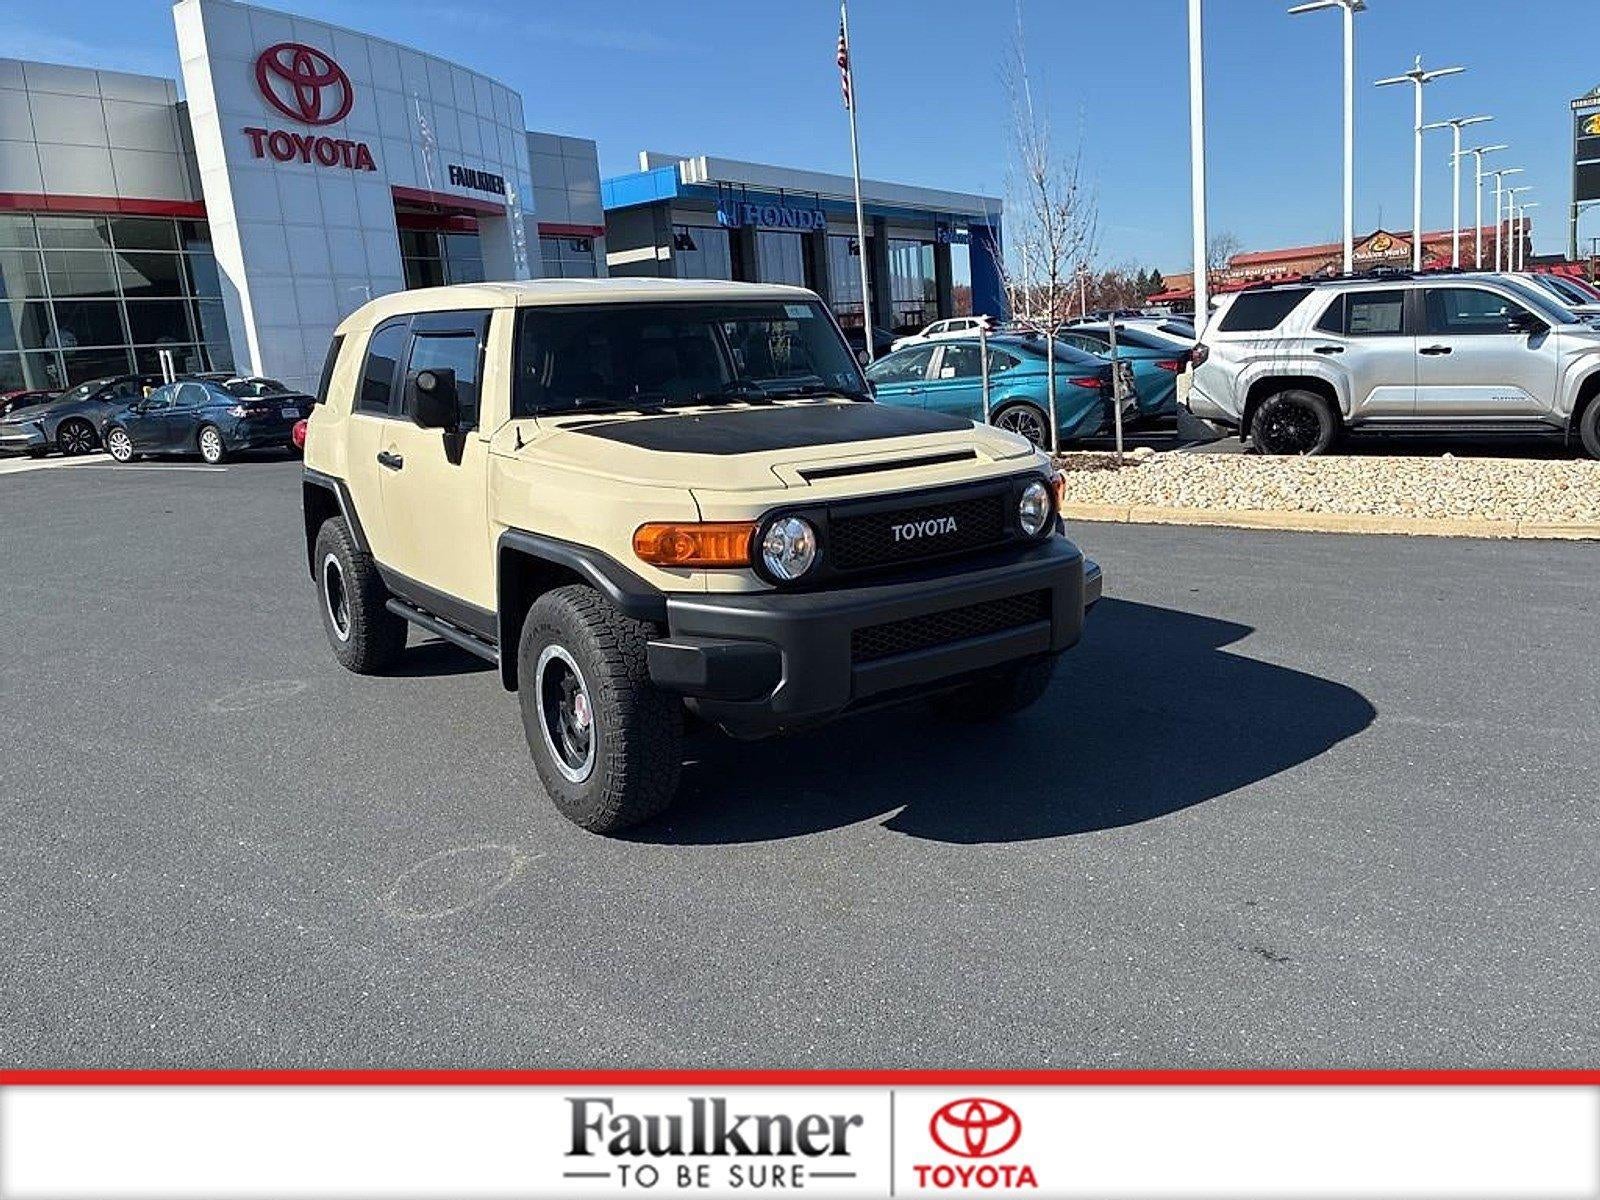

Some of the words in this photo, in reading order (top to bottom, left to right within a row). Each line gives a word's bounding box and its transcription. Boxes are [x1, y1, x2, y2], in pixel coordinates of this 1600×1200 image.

[244, 127, 377, 171] TOYOTA
[448, 164, 505, 195] FAULKNER
[743, 204, 826, 229] HONDA
[891, 516, 958, 541] TOYOTA
